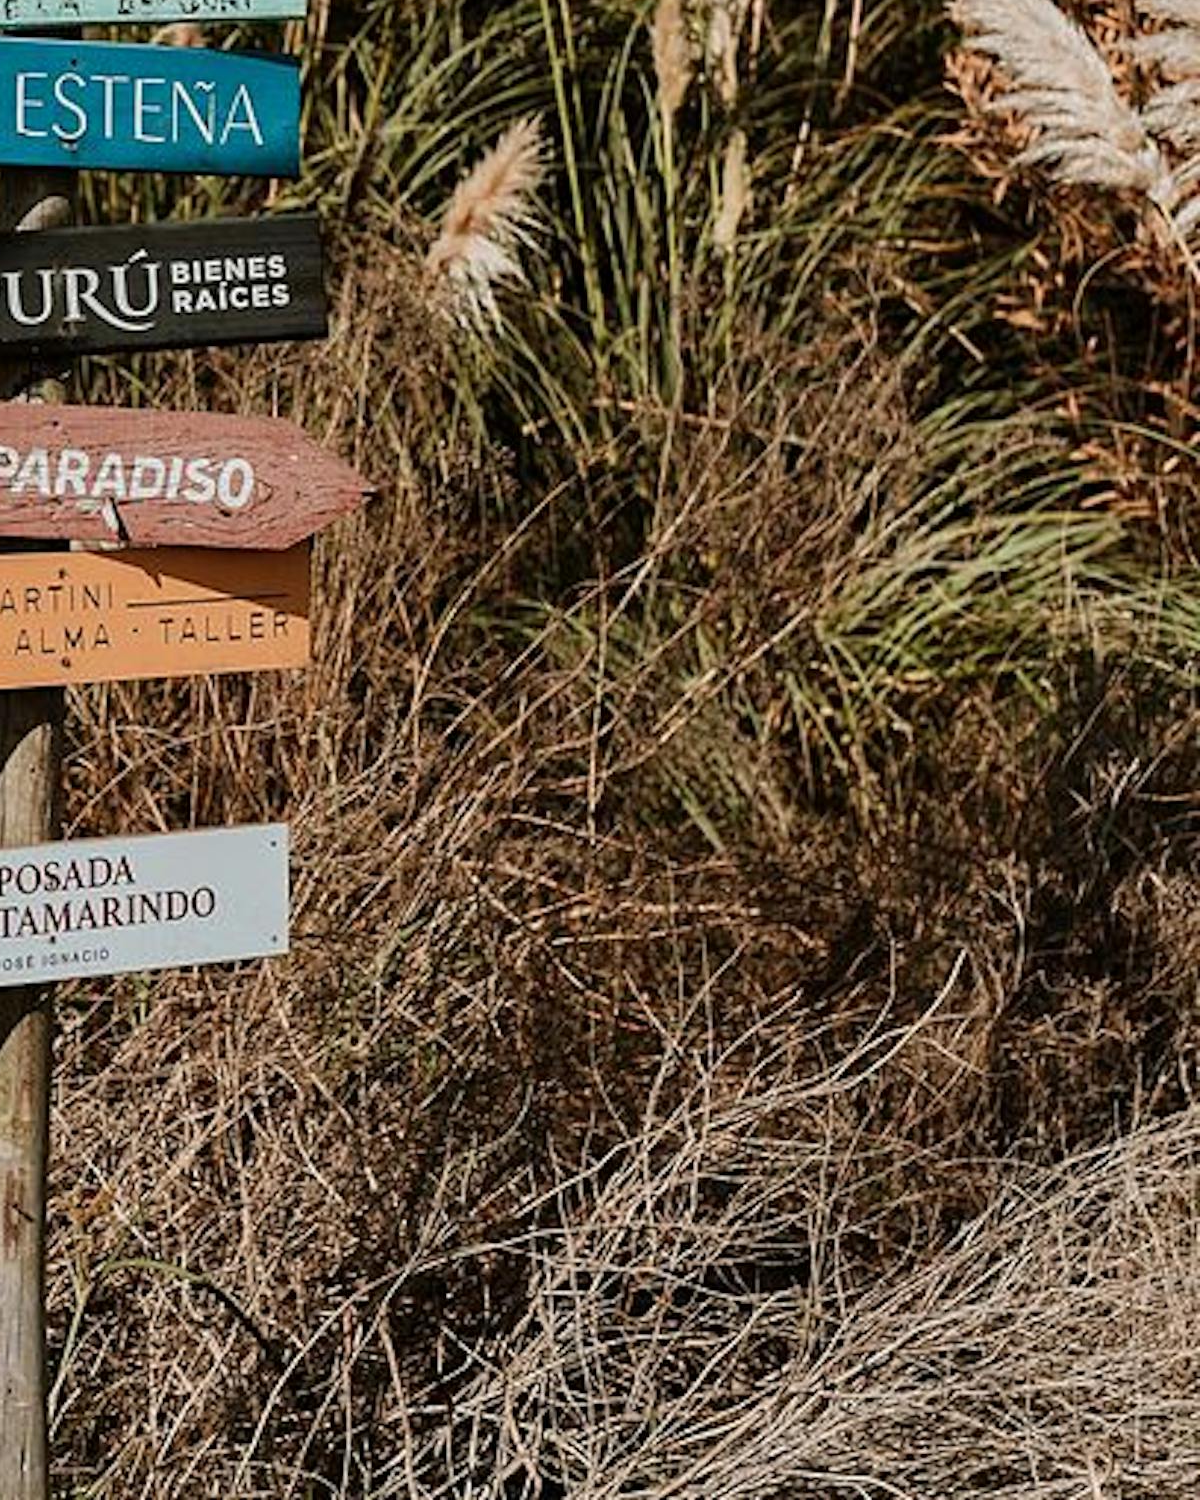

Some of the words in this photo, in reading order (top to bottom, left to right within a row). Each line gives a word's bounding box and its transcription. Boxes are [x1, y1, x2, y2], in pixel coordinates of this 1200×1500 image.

[16, 70, 264, 147] ESTEÑA
[171, 254, 287, 285] BIENES
[171, 283, 290, 314] RAÍCES
[14, 624, 111, 656] ALMA
[158, 610, 290, 645] TALLER
[41, 949, 110, 968] IGNACIO
